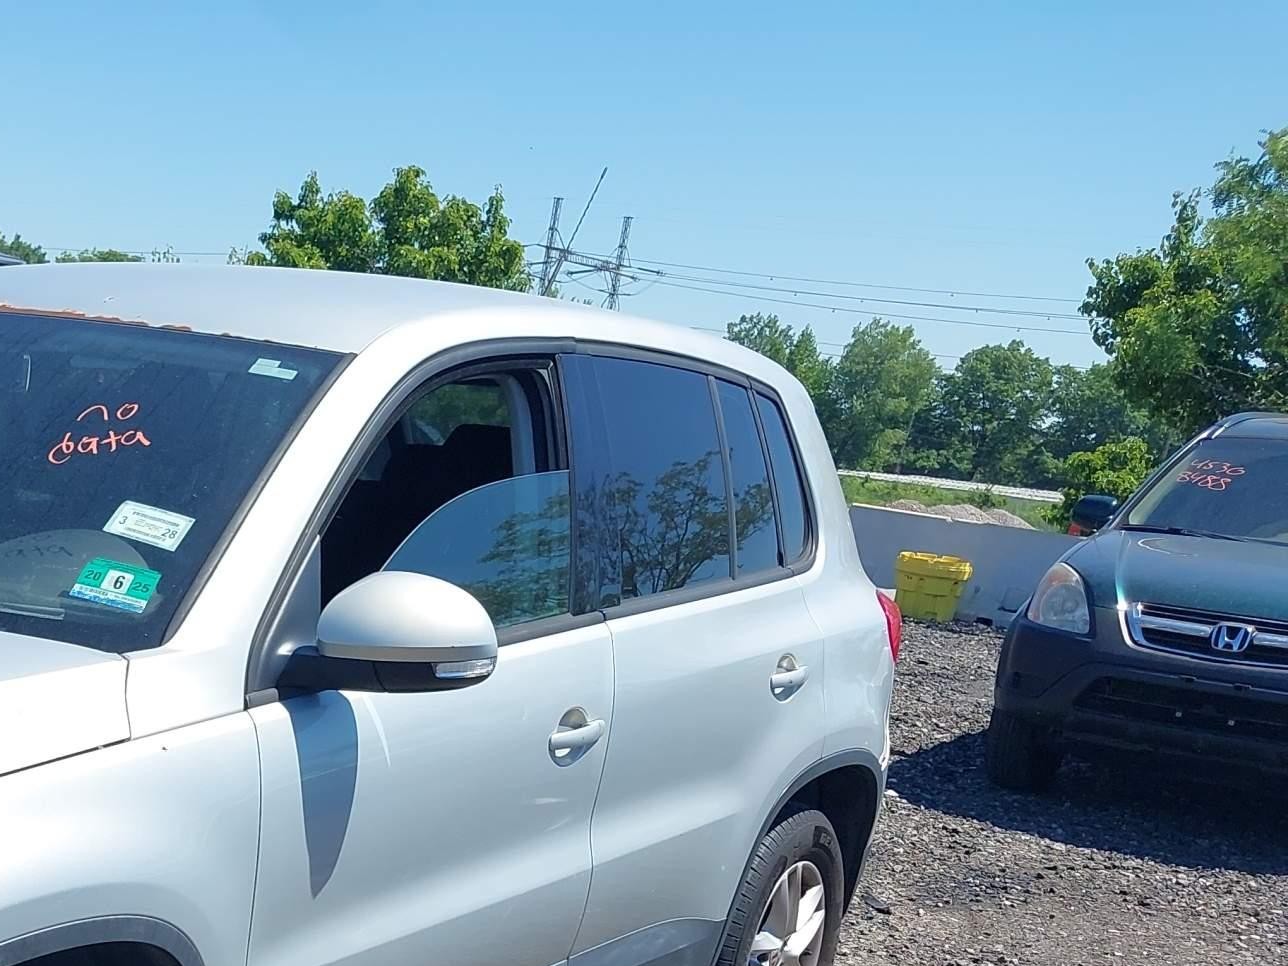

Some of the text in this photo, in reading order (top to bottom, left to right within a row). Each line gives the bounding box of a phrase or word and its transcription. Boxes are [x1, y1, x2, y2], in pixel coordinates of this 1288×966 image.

[118, 515, 128, 525] 3
[161, 528, 178, 540] 28
[84, 570, 152, 594] 20 6 25
